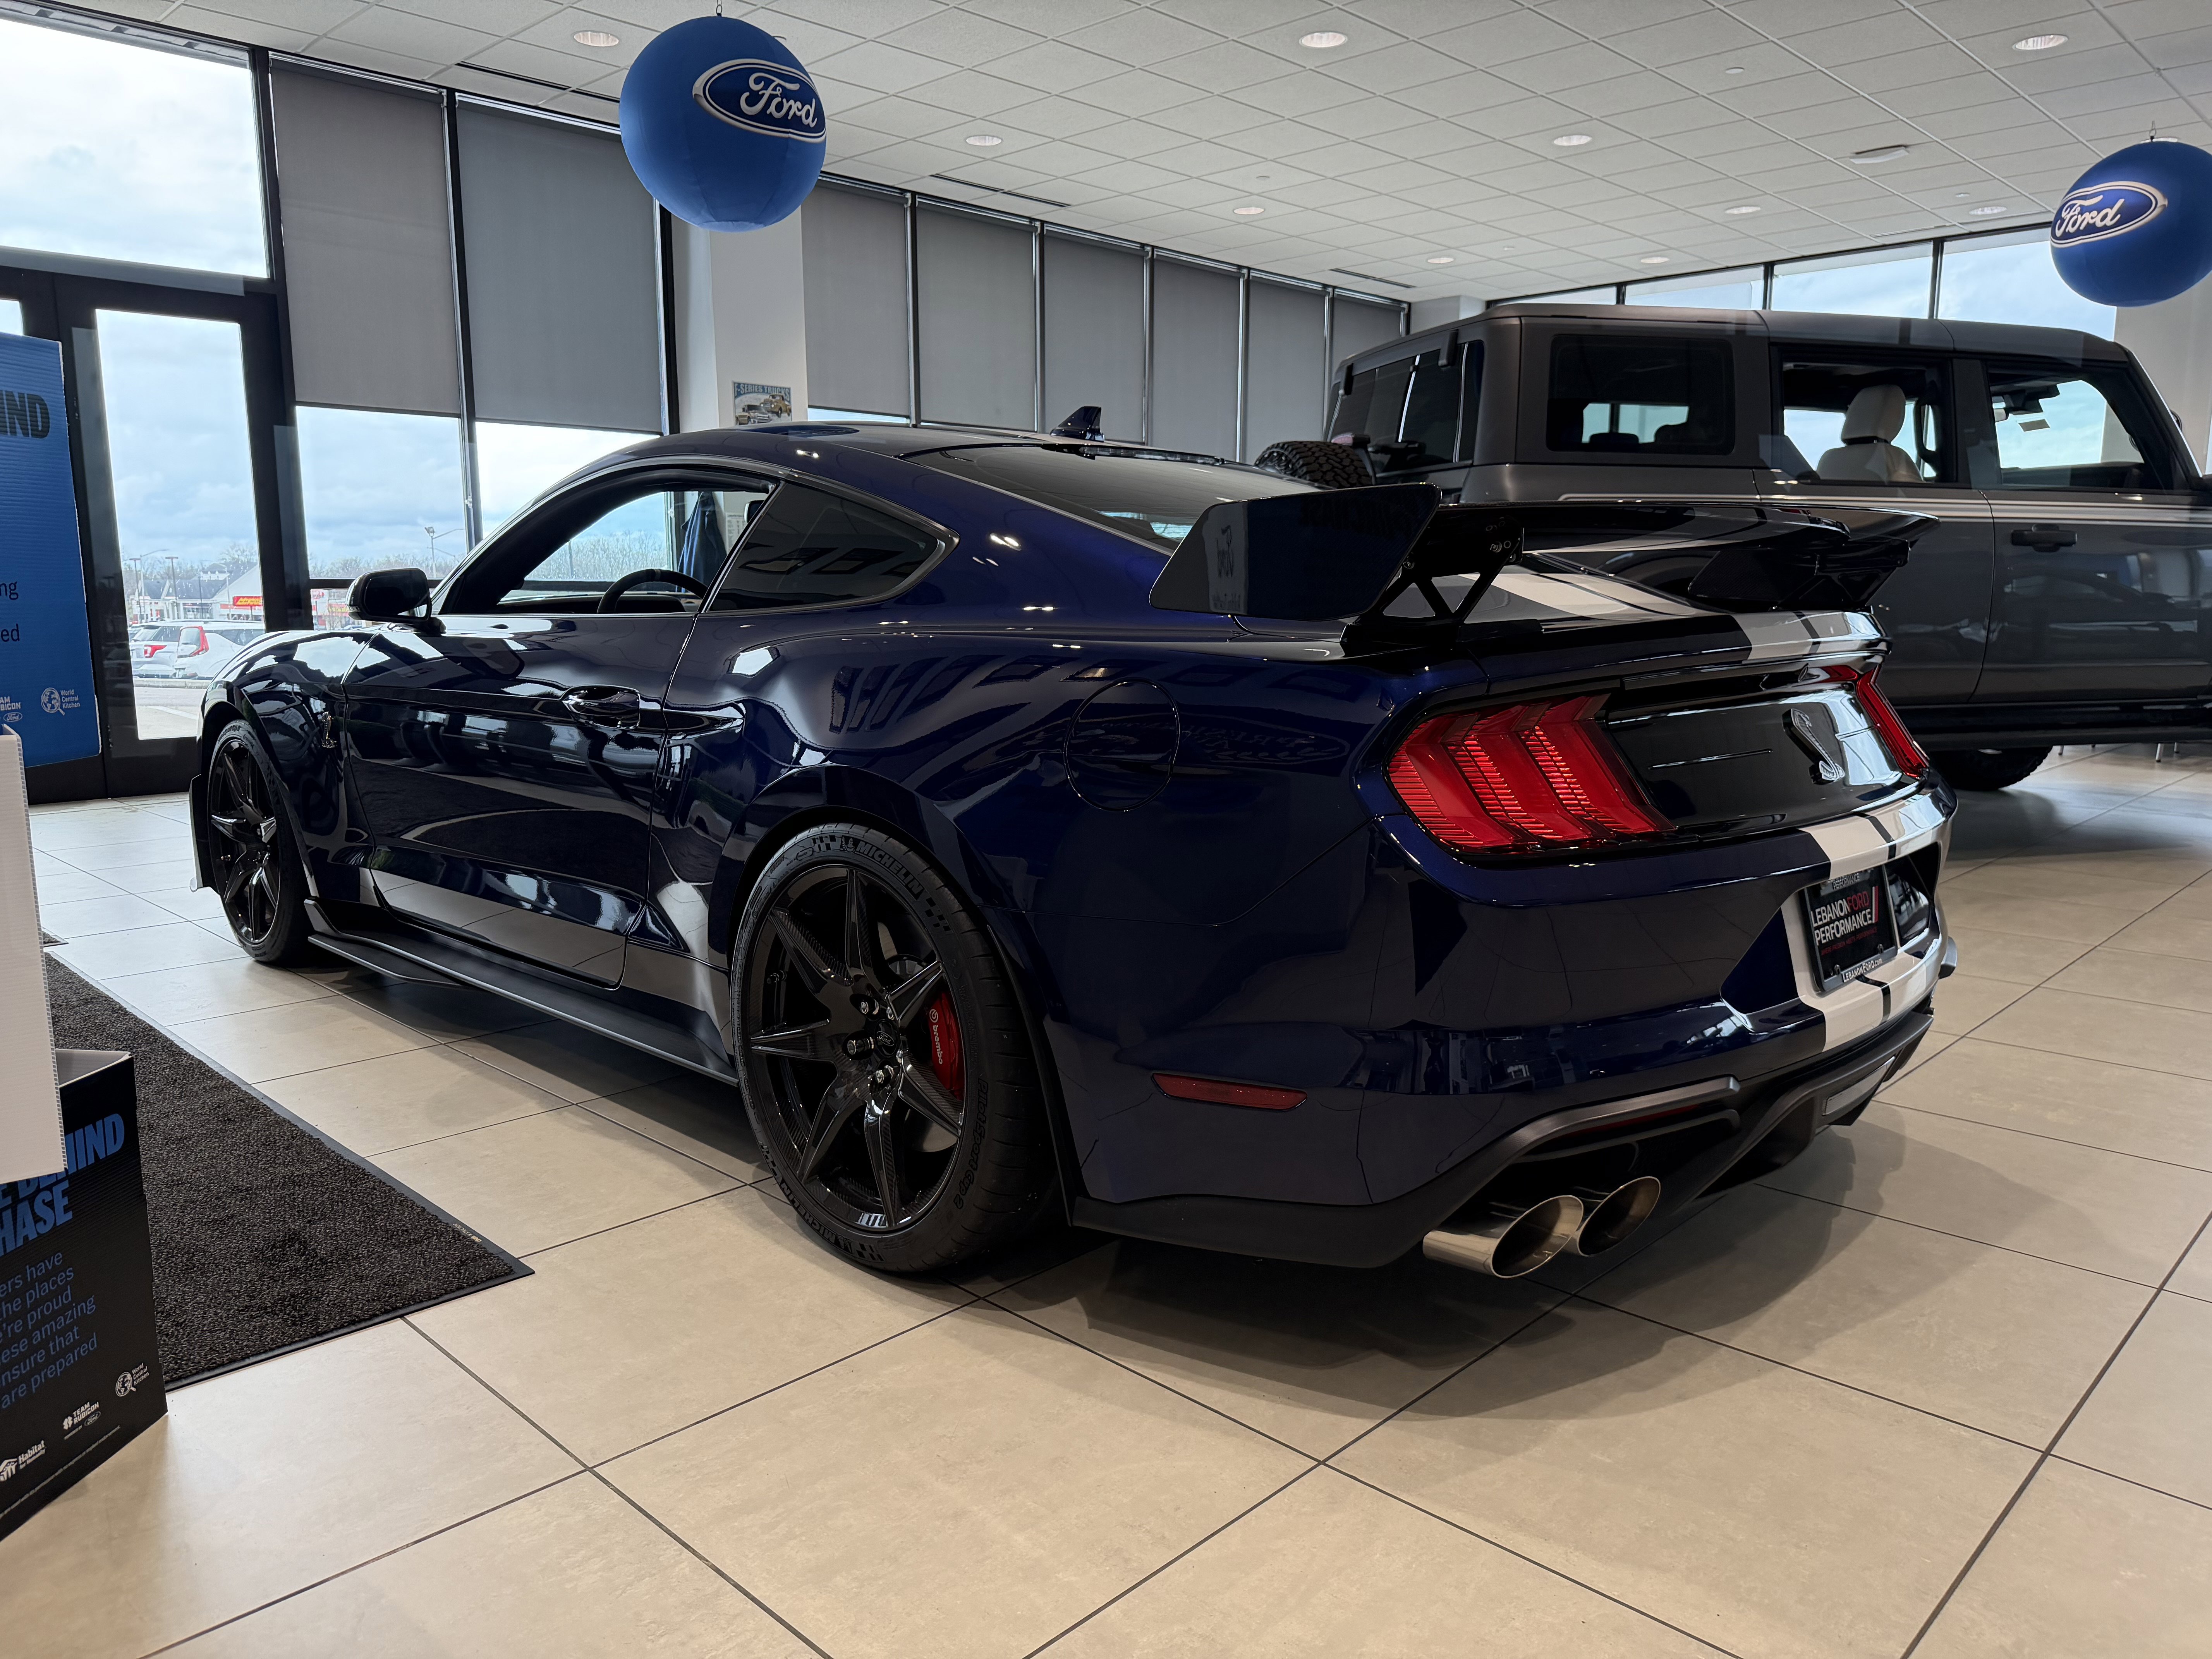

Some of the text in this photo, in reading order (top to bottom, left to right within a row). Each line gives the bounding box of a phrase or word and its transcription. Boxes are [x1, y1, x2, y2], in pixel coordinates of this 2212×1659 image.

[740, 72, 817, 128] Ford
[2055, 195, 2125, 237] Ford
[734, 383, 790, 401] F-SERIES TRUCKS
[856, 840, 924, 898] MICHELIN
[1814, 908, 1872, 946] PERFORMANCE
[878, 1032, 891, 1044] Ford
[933, 1025, 943, 1065] brembo
[953, 1078, 989, 1209] Pilot Sport Cup 2
[780, 1183, 837, 1243] MICHELIN
[26, 1252, 62, 1282] have
[26, 1267, 74, 1308] places
[27, 1285, 72, 1329] proud
[33, 1295, 96, 1344] amazing
[49, 1326, 80, 1355] that
[1, 1332, 97, 1408] are prepared
[132, 1363, 144, 1374] World
[133, 1366, 148, 1380] Central
[134, 1372, 149, 1385] Kitchen
[73, 1401, 90, 1417] TEAM
[74, 1401, 99, 1424] RUBICON
[87, 1413, 98, 1424] Ford
[19, 1440, 45, 1464] Habitat
